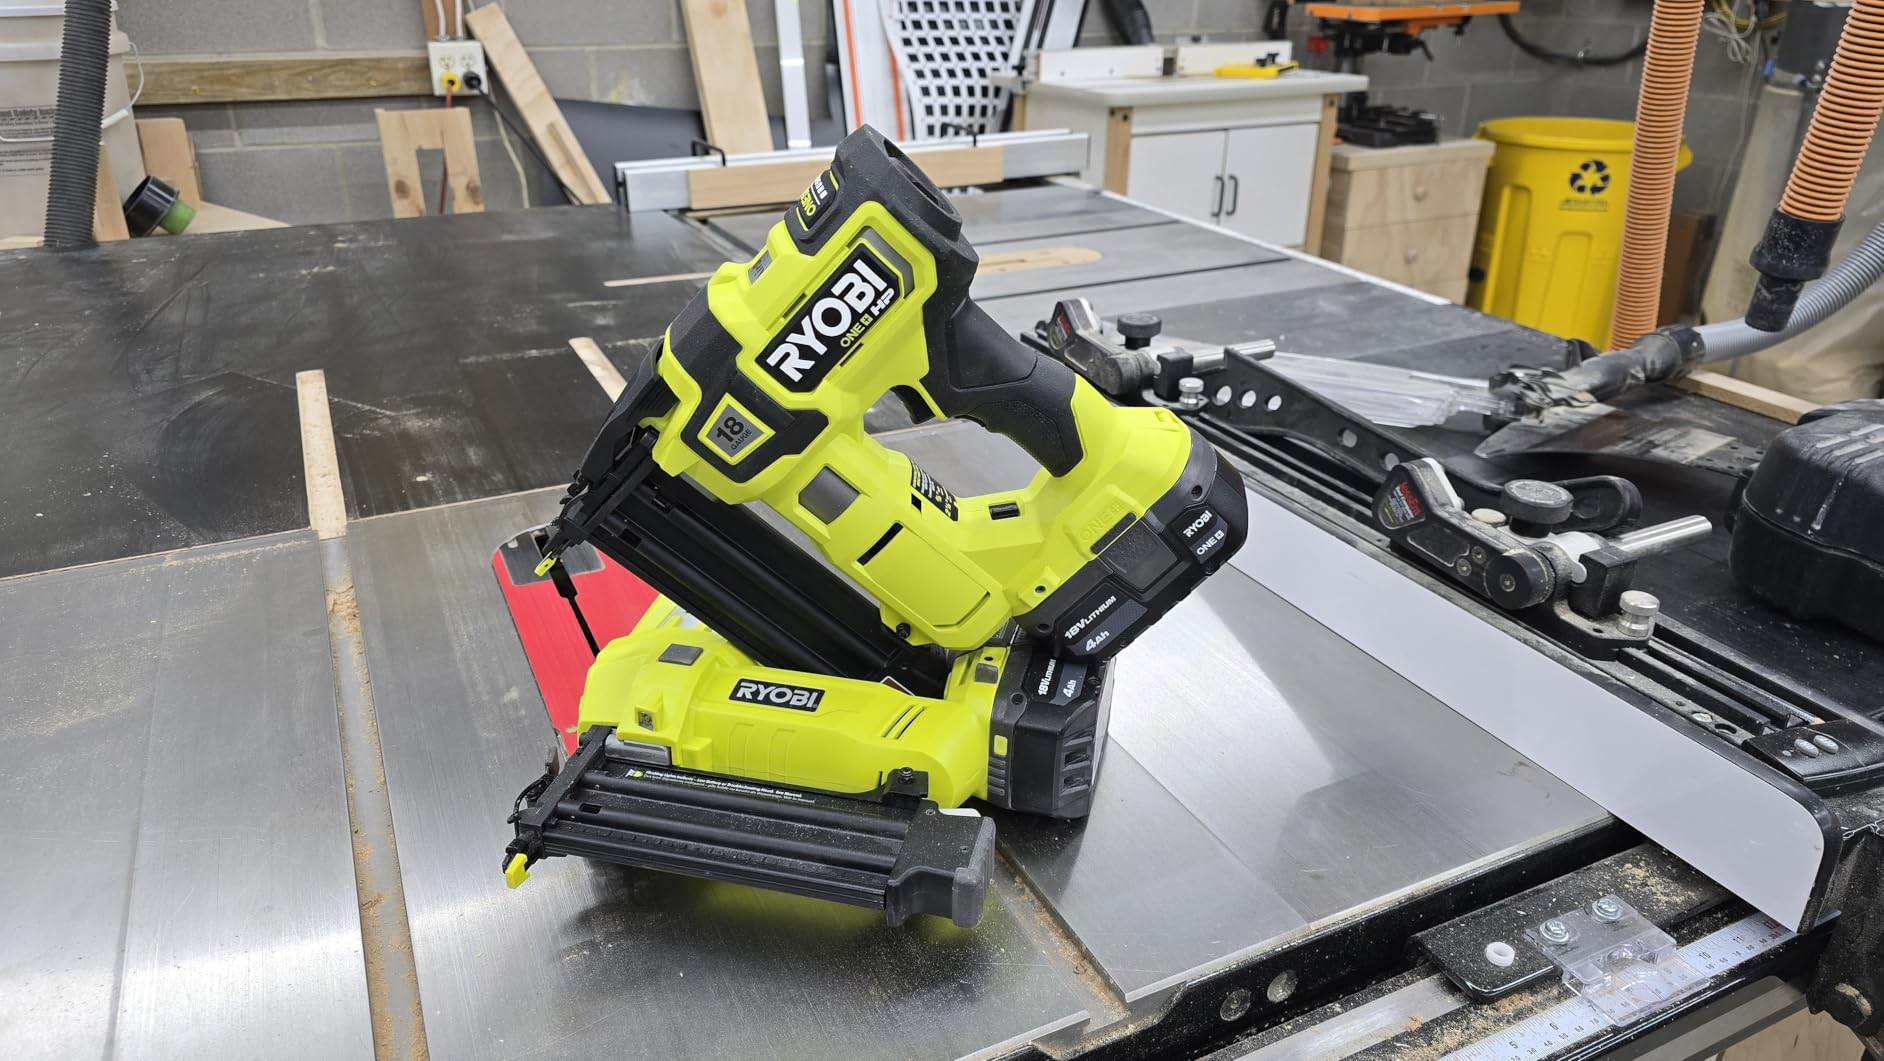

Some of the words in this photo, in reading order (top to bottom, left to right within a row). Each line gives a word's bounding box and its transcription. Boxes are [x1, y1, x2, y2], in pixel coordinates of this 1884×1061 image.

[870, 287, 895, 317] HP
[766, 259, 887, 382] RYOBI
[716, 416, 744, 443] 18
[731, 428, 753, 450] GAUGE
[1183, 510, 1213, 538] RYOBI
[1085, 629, 1110, 652] 4Ah
[736, 682, 819, 708] RYOBI
[1062, 679, 1077, 698] 4Ah
[1733, 936, 1744, 944] 11
[1699, 951, 1711, 960] 10
[1587, 1004, 1597, 1012] 7
[1550, 1022, 1558, 1030] 6
[1509, 1041, 1518, 1049] 5
